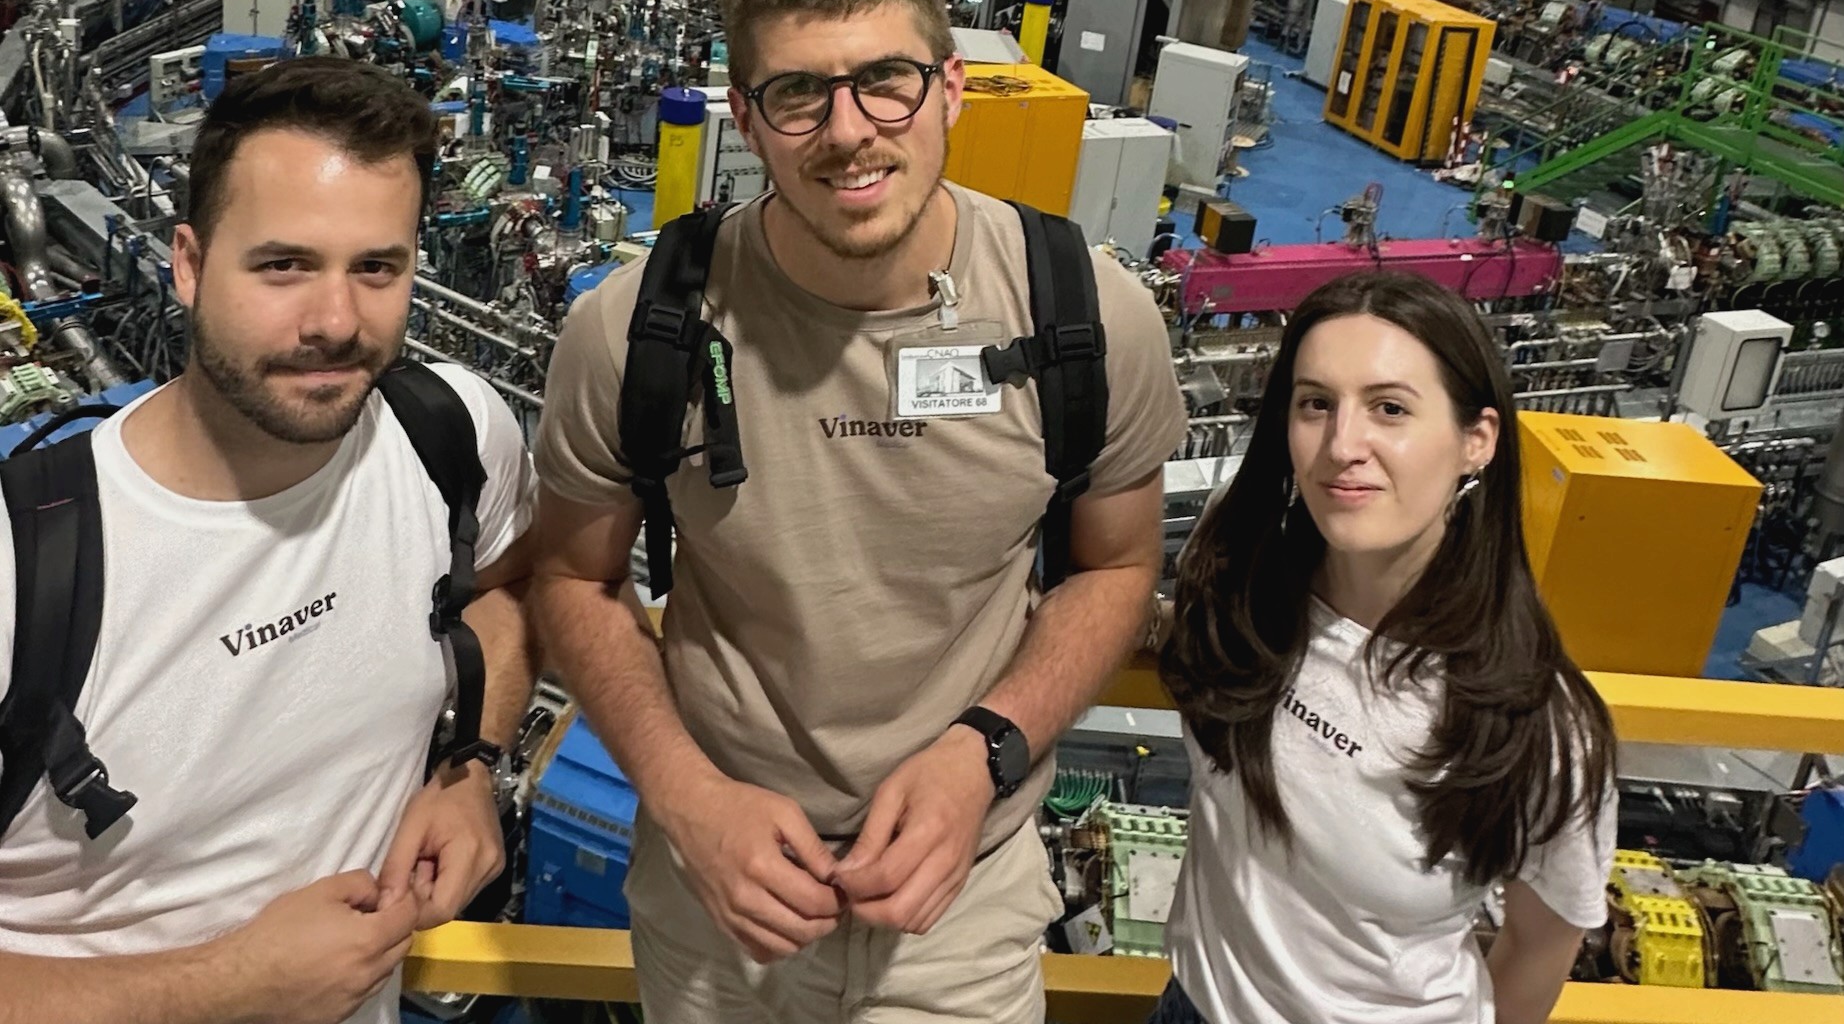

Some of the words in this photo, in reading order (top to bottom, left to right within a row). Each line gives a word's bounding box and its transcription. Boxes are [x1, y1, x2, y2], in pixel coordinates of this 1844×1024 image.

[911, 398, 973, 409] VISITATORE
[819, 414, 928, 439] Vinaver
[220, 591, 337, 656] Vinaver
[1283, 688, 1362, 758] inaver
